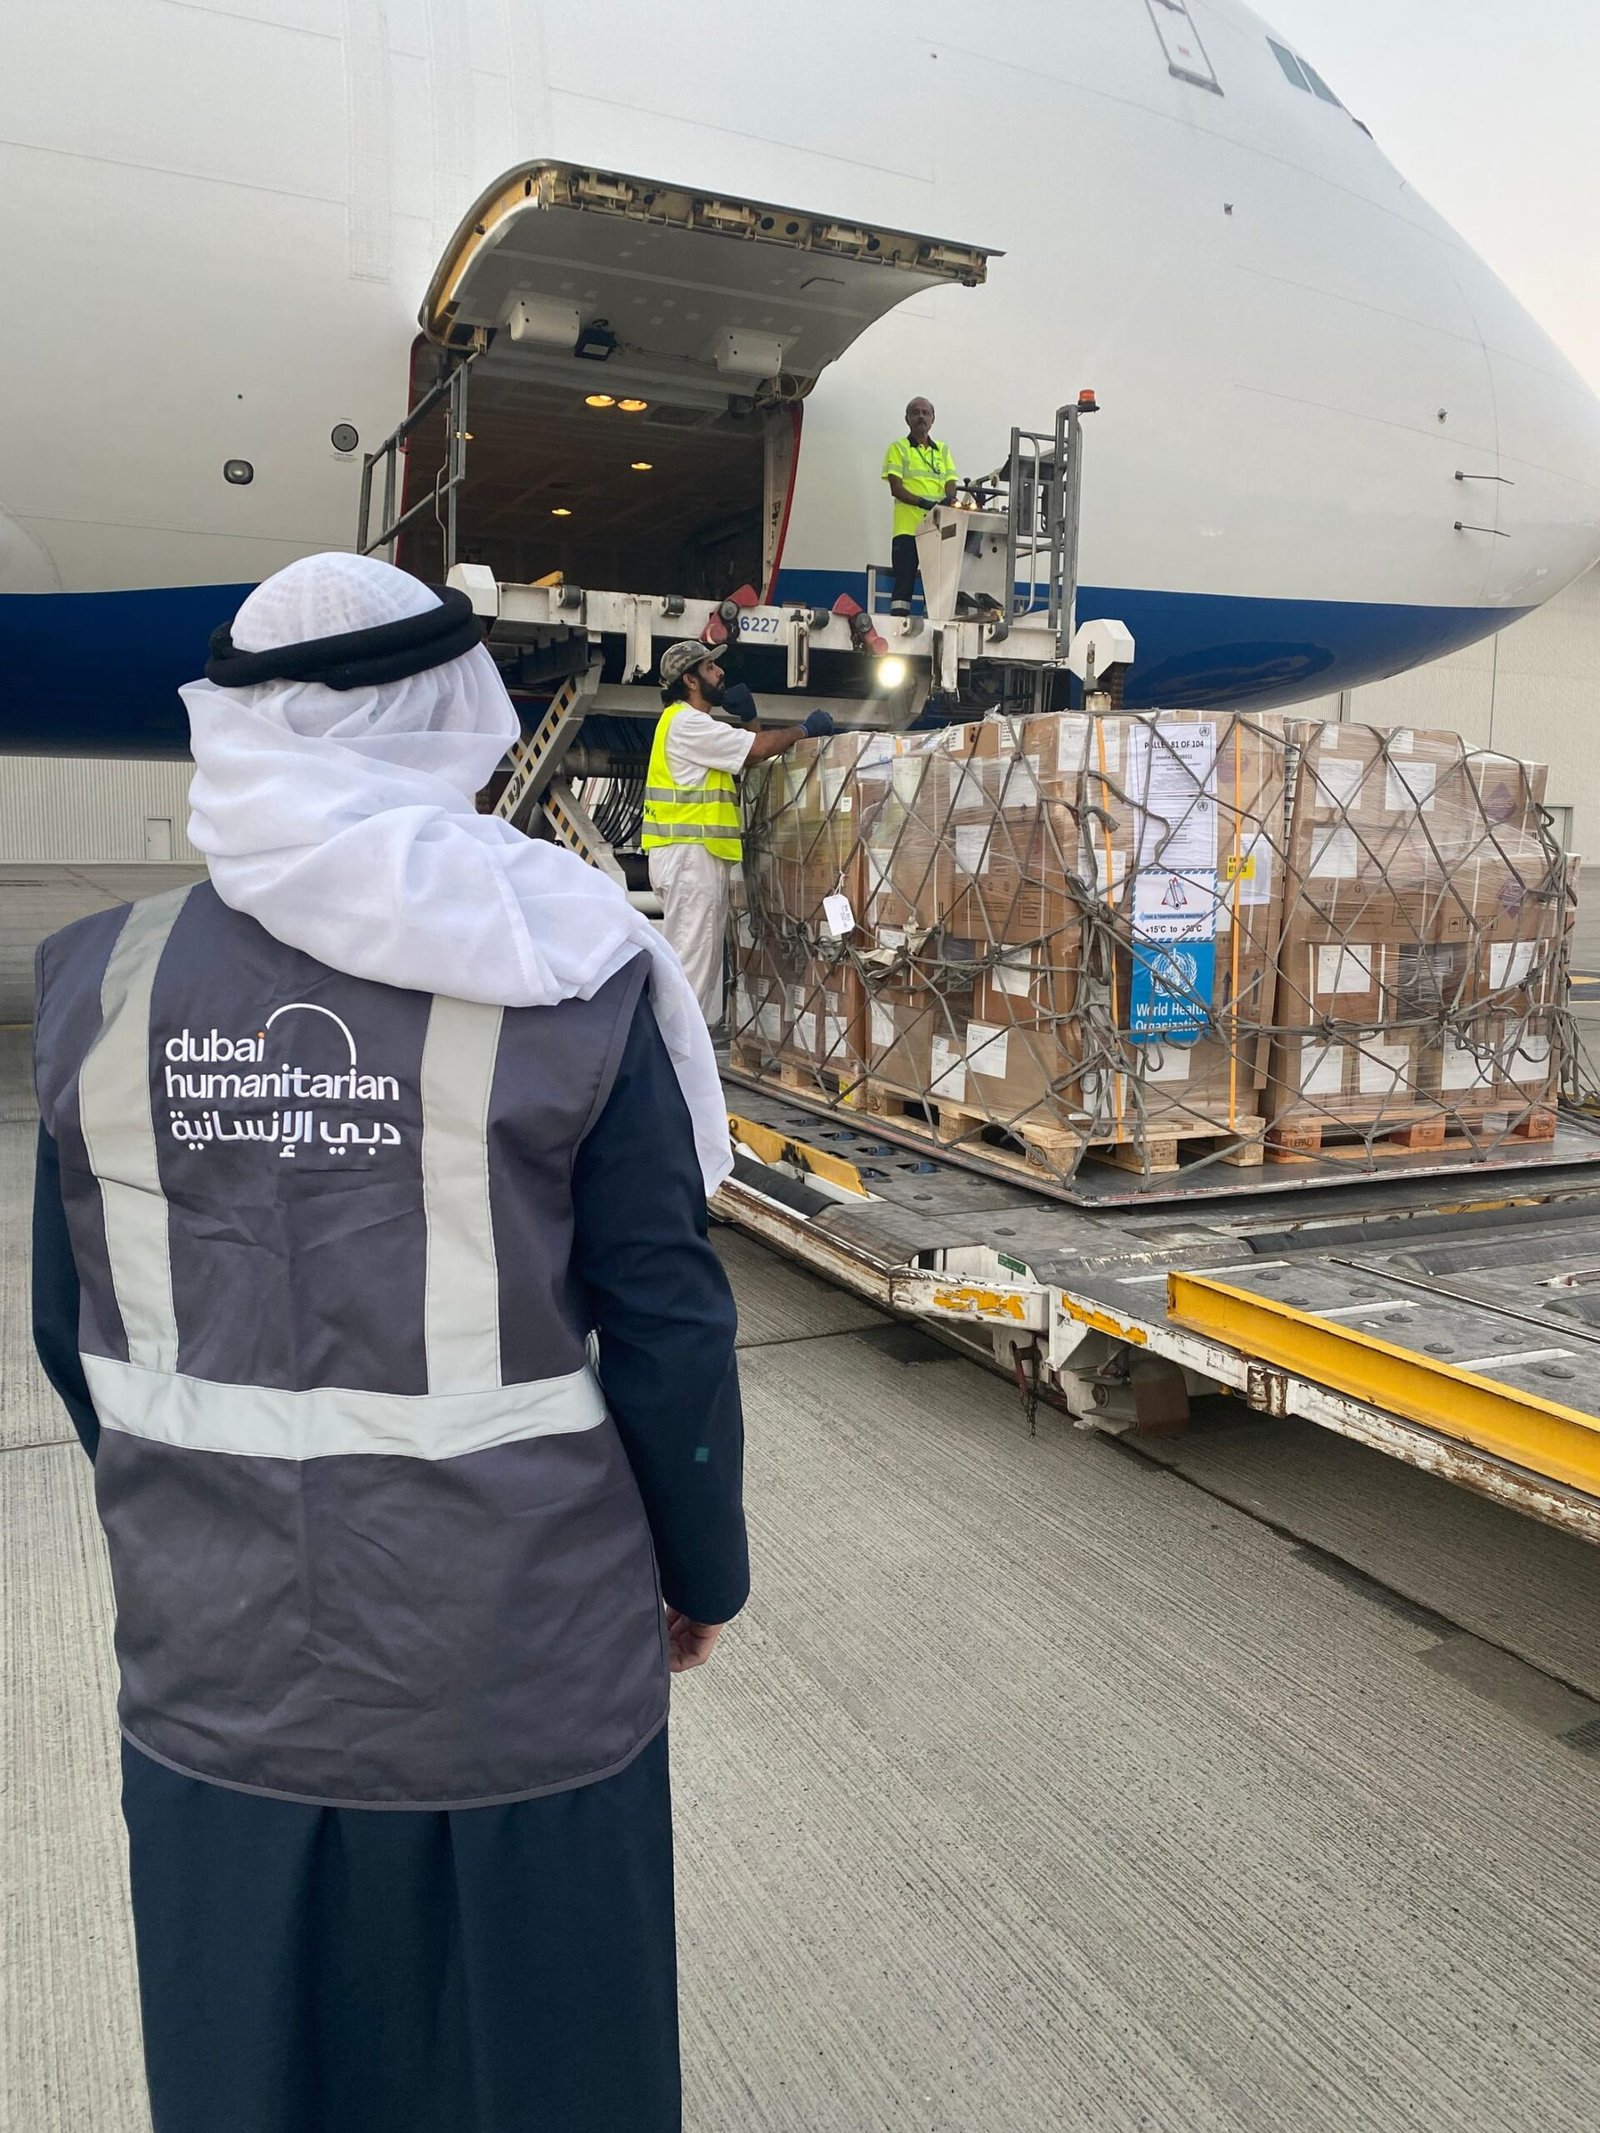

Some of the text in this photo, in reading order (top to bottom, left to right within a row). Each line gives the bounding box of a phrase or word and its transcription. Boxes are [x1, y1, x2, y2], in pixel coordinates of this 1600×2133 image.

[740, 616, 779, 633] 6227
[1171, 740, 1179, 748] 81
[1181, 740, 1190, 748] OF
[1192, 739, 1204, 748] 104
[165, 1028, 265, 1063] dubai
[165, 1063, 400, 1101] humanitarian
[169, 1110, 402, 1158] دبي الإنسانية
